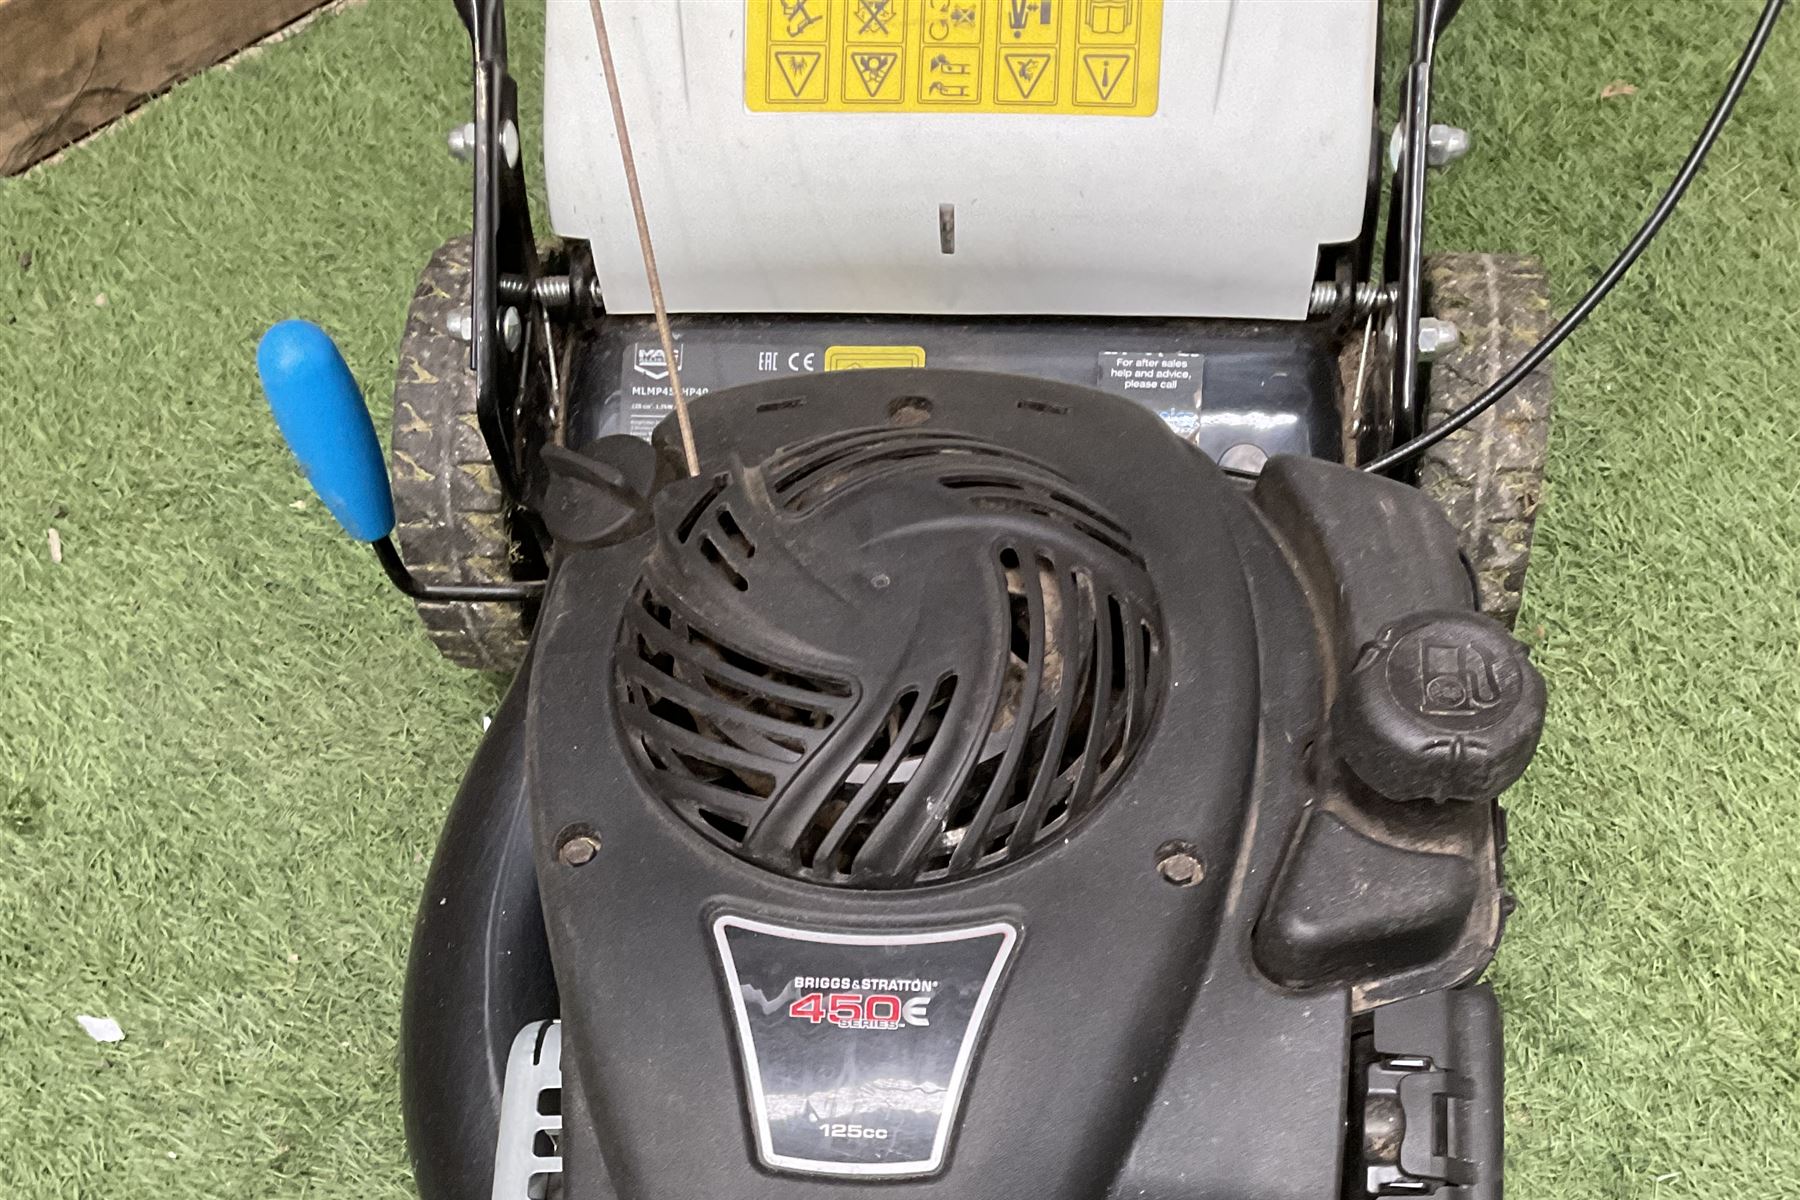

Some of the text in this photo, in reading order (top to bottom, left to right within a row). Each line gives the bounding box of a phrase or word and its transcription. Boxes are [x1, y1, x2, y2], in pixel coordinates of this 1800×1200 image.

[758, 352, 815, 371] EAC CE
[1116, 358, 1188, 368] For after sales
[1111, 368, 1192, 380] help and advice,
[1124, 380, 1177, 390] please call
[838, 1018, 898, 1030] SERIES
[819, 1123, 888, 1139] 125cc
